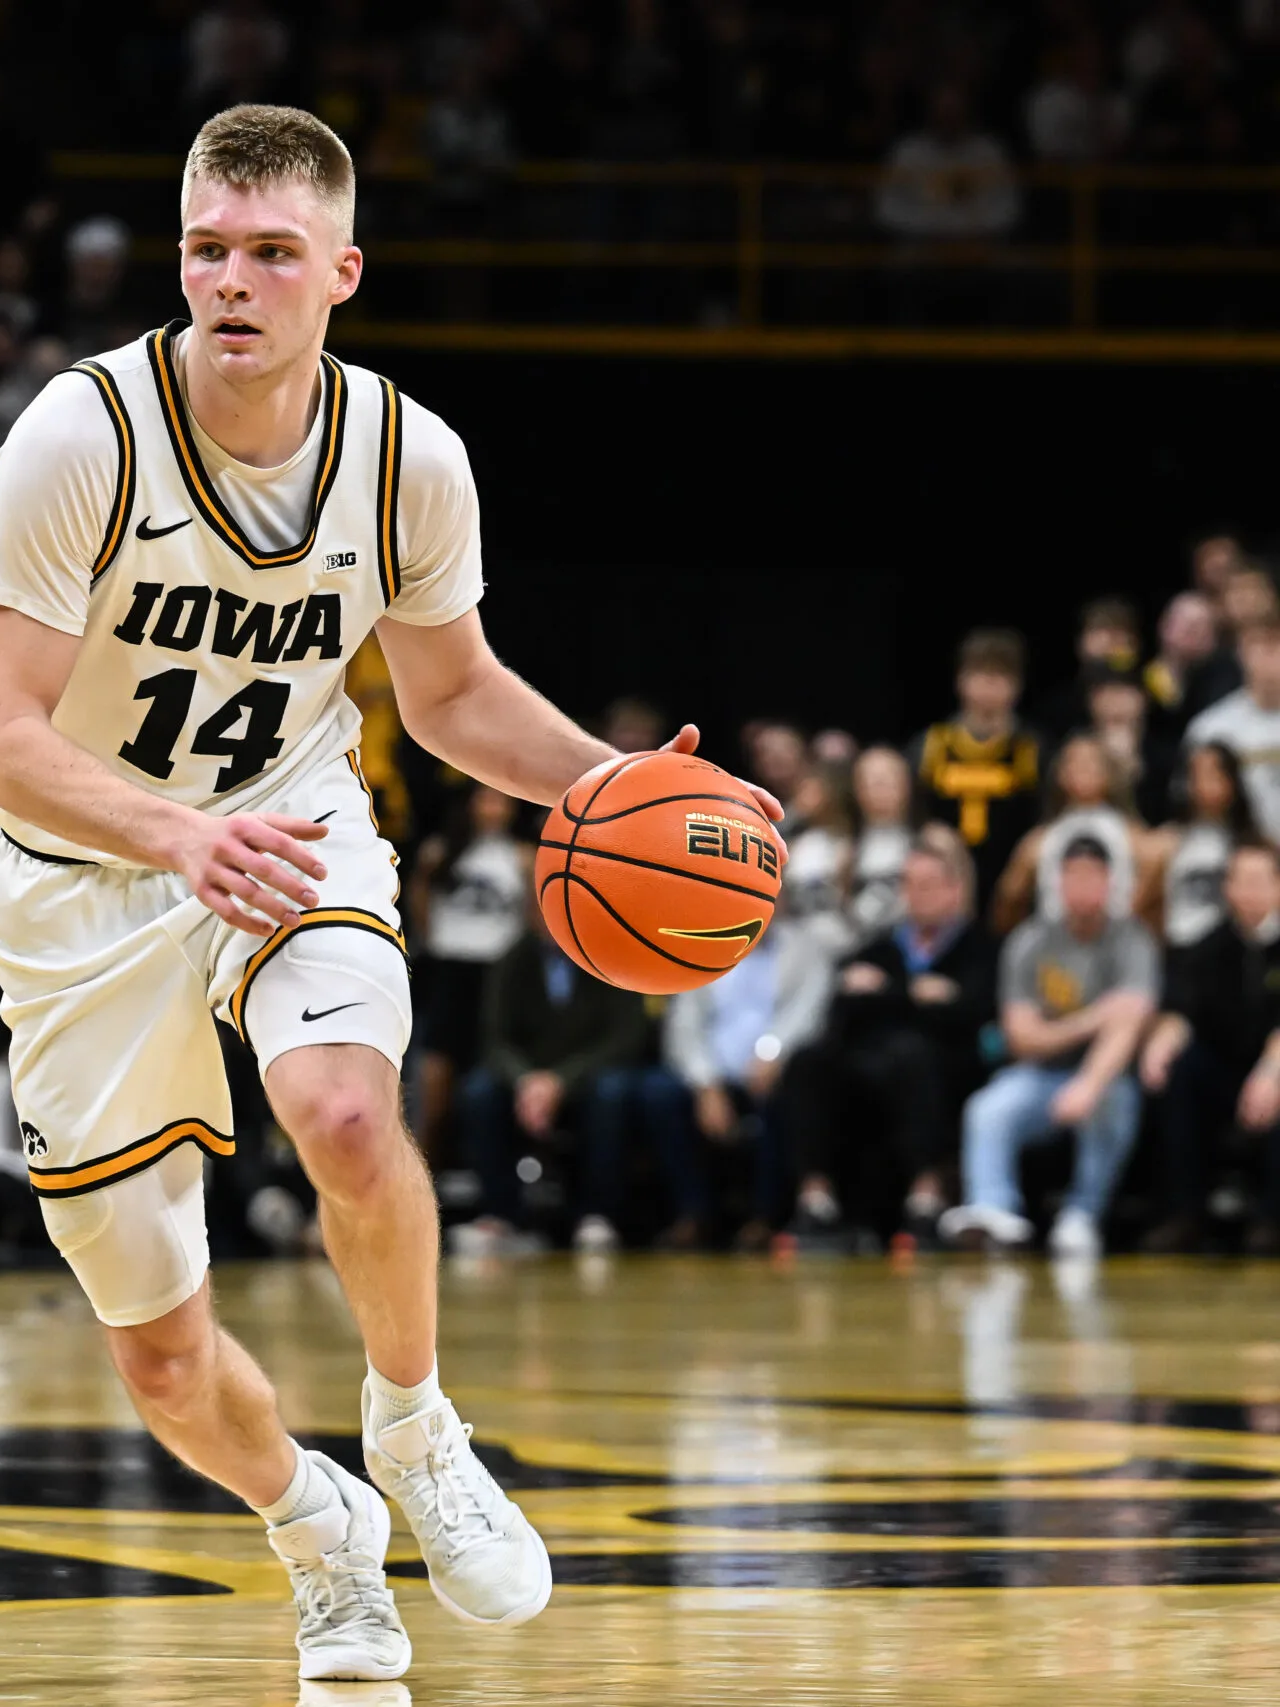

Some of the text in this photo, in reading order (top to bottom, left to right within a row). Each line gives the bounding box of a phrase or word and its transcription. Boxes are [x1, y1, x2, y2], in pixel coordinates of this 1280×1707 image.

[113, 581, 342, 664] IOWA
[118, 668, 291, 793] 14
[685, 812, 768, 838] MPIONSHIP
[686, 821, 778, 880] ELITE
